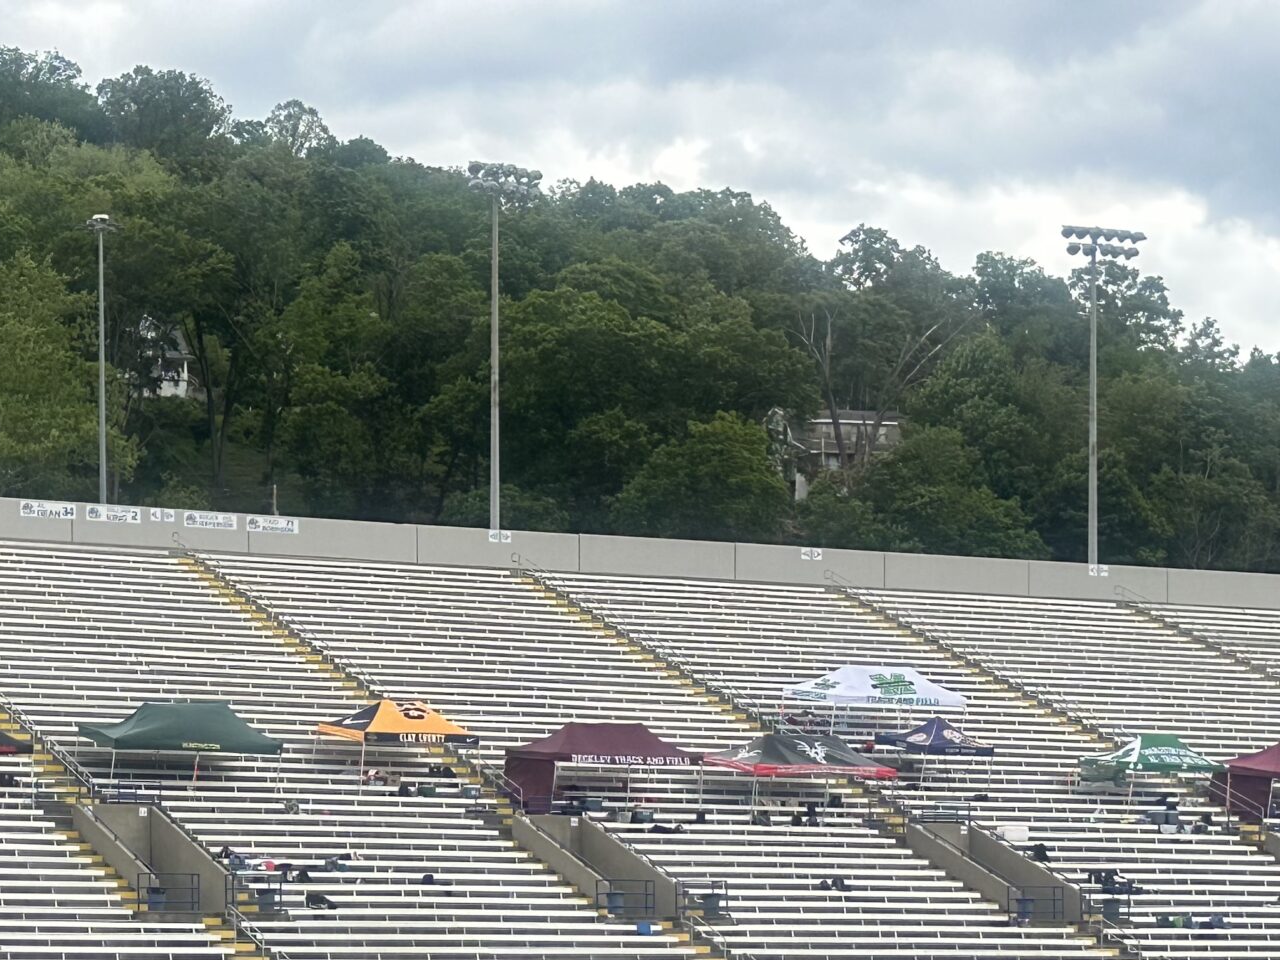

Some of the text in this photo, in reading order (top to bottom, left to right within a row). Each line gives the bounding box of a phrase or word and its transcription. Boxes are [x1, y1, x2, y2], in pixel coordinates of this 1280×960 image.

[614, 755, 645, 765] TRACK
[646, 756, 664, 766] AND
[665, 757, 691, 766] FIELD
